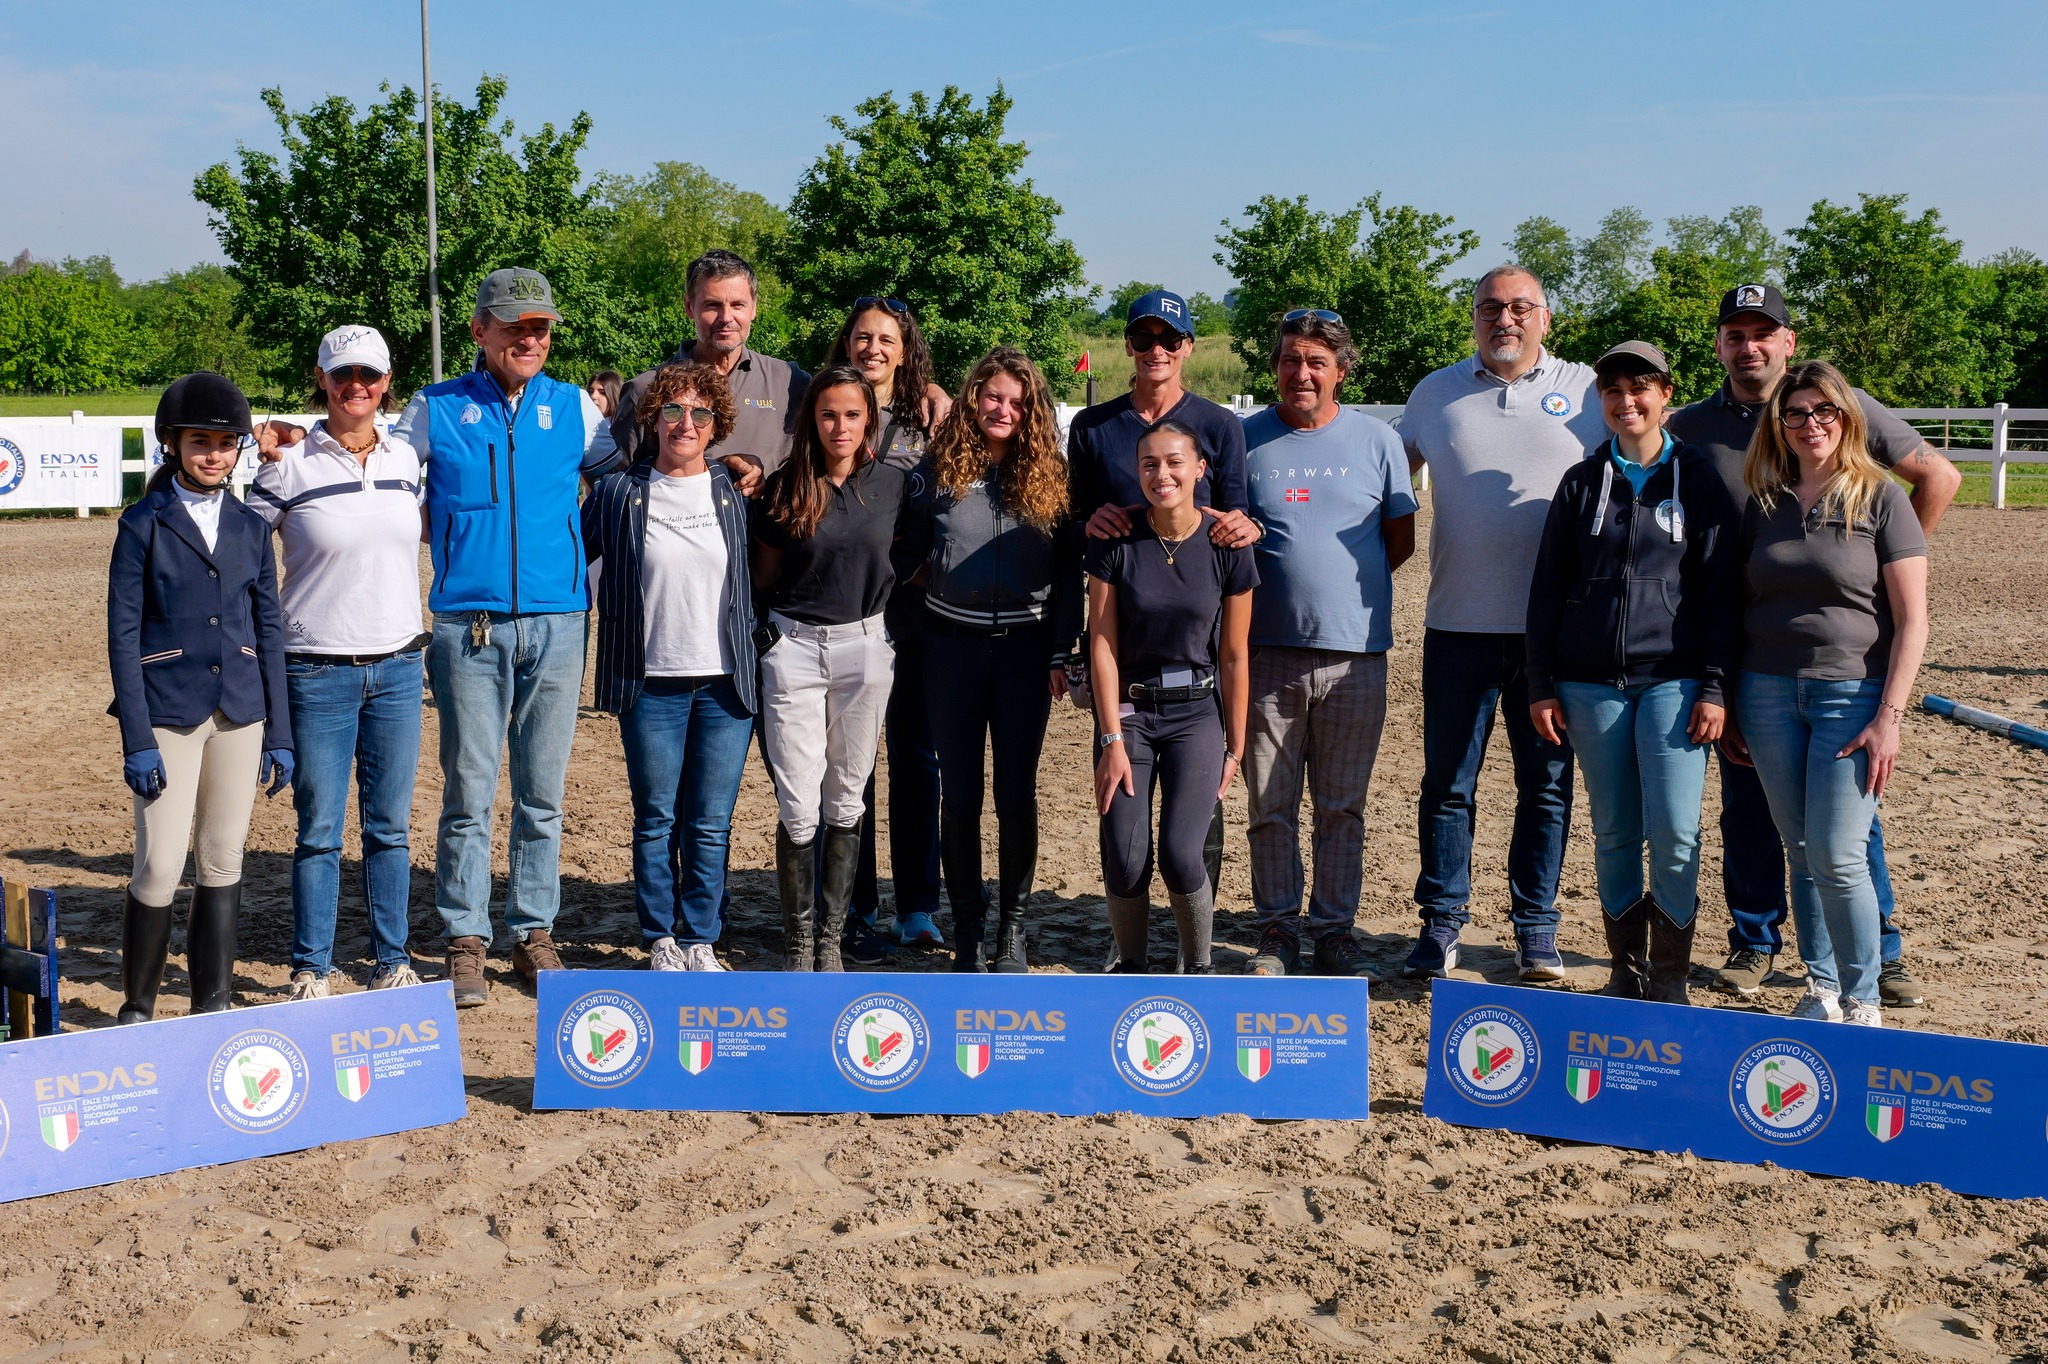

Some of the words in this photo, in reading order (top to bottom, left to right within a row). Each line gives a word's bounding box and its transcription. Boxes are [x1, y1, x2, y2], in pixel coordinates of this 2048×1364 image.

[5, 442, 24, 478] ITALIANO
[40, 453, 98, 464] ENDAS
[41, 470, 99, 478] ITALIA
[1251, 467, 1348, 481] NORWAY
[563, 1012, 578, 1034] ENTE
[576, 995, 619, 1014] SPORTIVO
[620, 999, 647, 1035] ITALIANO
[679, 1006, 788, 1029] ENDAS
[838, 1014, 853, 1037] ENTE
[851, 998, 894, 1016] SPORTIVO
[895, 1002, 923, 1038] ITALIANO
[955, 1010, 1066, 1032] ENDAS
[1117, 1018, 1133, 1041] ENTE
[1130, 1001, 1174, 1020] SPORTIVO
[1175, 1005, 1204, 1042] ITALIANO
[1236, 1013, 1348, 1035] ENDAS
[331, 1019, 439, 1055] ENDAS
[1450, 1024, 1466, 1047] ENTE
[1464, 1010, 1508, 1027] SPORTIVO
[1508, 1017, 1535, 1056] ITALIANO
[399, 1044, 440, 1055] PROMOZIONE
[598, 1044, 625, 1068] ENDAS
[1568, 1030, 1682, 1065] ENDAS
[213, 1058, 227, 1083] ENTE
[223, 1035, 267, 1058] SPORTIVO
[269, 1036, 301, 1070] ITALIANO
[339, 1058, 365, 1068] ITALIA
[373, 1056, 404, 1066] SPORTIVA
[374, 1060, 422, 1072] RICONOSCIUTO
[566, 1054, 590, 1078] COMITATO
[590, 1072, 624, 1082] REGIONALE
[623, 1055, 641, 1076] VENETO
[875, 1047, 902, 1071] ENDAS
[1155, 1051, 1182, 1075] ENDAS
[1571, 1059, 1599, 1068] ITALIA
[1634, 1064, 1681, 1076] PROMOZIONE
[1736, 1057, 1754, 1082] ENTE
[1752, 1044, 1800, 1061] SPORTIVO
[1800, 1051, 1831, 1092] ITALIANO
[35, 1062, 157, 1101] ENDAS
[842, 1057, 866, 1081] COMITATO
[866, 1075, 900, 1085] REGIONALE
[899, 1059, 918, 1079] VENETO
[1121, 1061, 1145, 1085] COMITATO
[1146, 1079, 1181, 1089] REGIONALE
[1181, 1062, 1199, 1082] VENETO
[1483, 1063, 1512, 1085] ENDAS
[1606, 1075, 1657, 1086] RICONOSCIUTO
[1607, 1068, 1640, 1077] SPORTIVA
[1452, 1068, 1474, 1094] COMITATO
[1474, 1091, 1508, 1100] REGIONALE
[1508, 1076, 1528, 1095] VENETO
[1867, 1065, 1994, 1102] ENDAS
[82, 1098, 101, 1106] ENTE
[112, 1088, 159, 1101] PROMOZIONE
[83, 1102, 118, 1112] SPORTIVA
[256, 1084, 281, 1112] ENDAS
[1871, 1096, 1902, 1105] ITALIA
[1911, 1098, 1931, 1107] ENTE
[1941, 1102, 1992, 1114] PROMOZIONE
[43, 1104, 74, 1115] ITALIA
[84, 1106, 138, 1120] RICONOSCIUTO
[221, 1104, 248, 1126] COMITATO
[249, 1114, 283, 1127] REGIONALE
[283, 1092, 300, 1115] VENETO
[1774, 1099, 1805, 1123] ENDAS
[1910, 1106, 1947, 1115] SPORTIVA
[1910, 1113, 1967, 1125] RICONOSCIUTO
[1739, 1104, 1763, 1131] COMITATO
[1764, 1128, 1802, 1139] REGIONALE
[1802, 1114, 1823, 1134] VENETO
[1925, 1122, 1945, 1130] CONI
